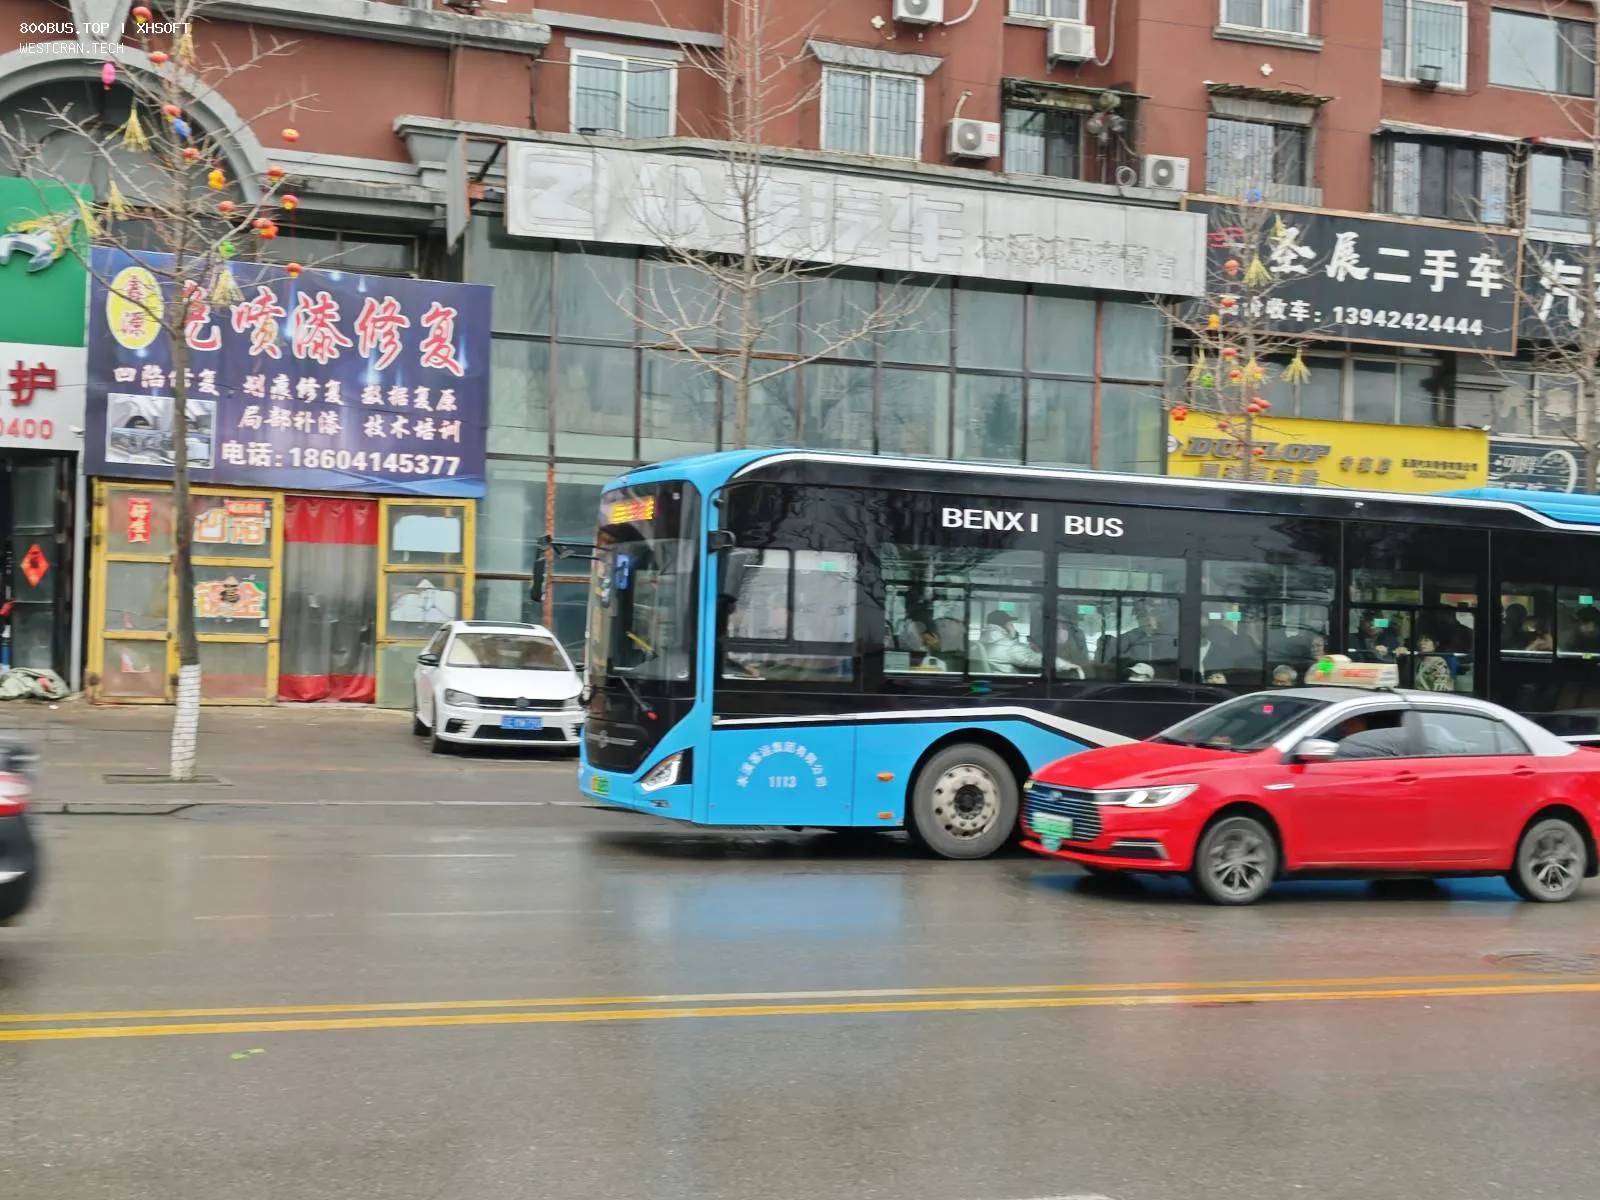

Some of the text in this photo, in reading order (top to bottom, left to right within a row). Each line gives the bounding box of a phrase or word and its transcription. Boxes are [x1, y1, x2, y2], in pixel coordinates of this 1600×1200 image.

[1269, 226, 1504, 298] 圣展二手车
[1332, 306, 1484, 336] 13942424444
[8, 360, 57, 406] 护
[363, 414, 462, 444] 技术培训
[220, 440, 462, 476] 电话: 18604145377
[941, 507, 1125, 538] BENXI BUS
